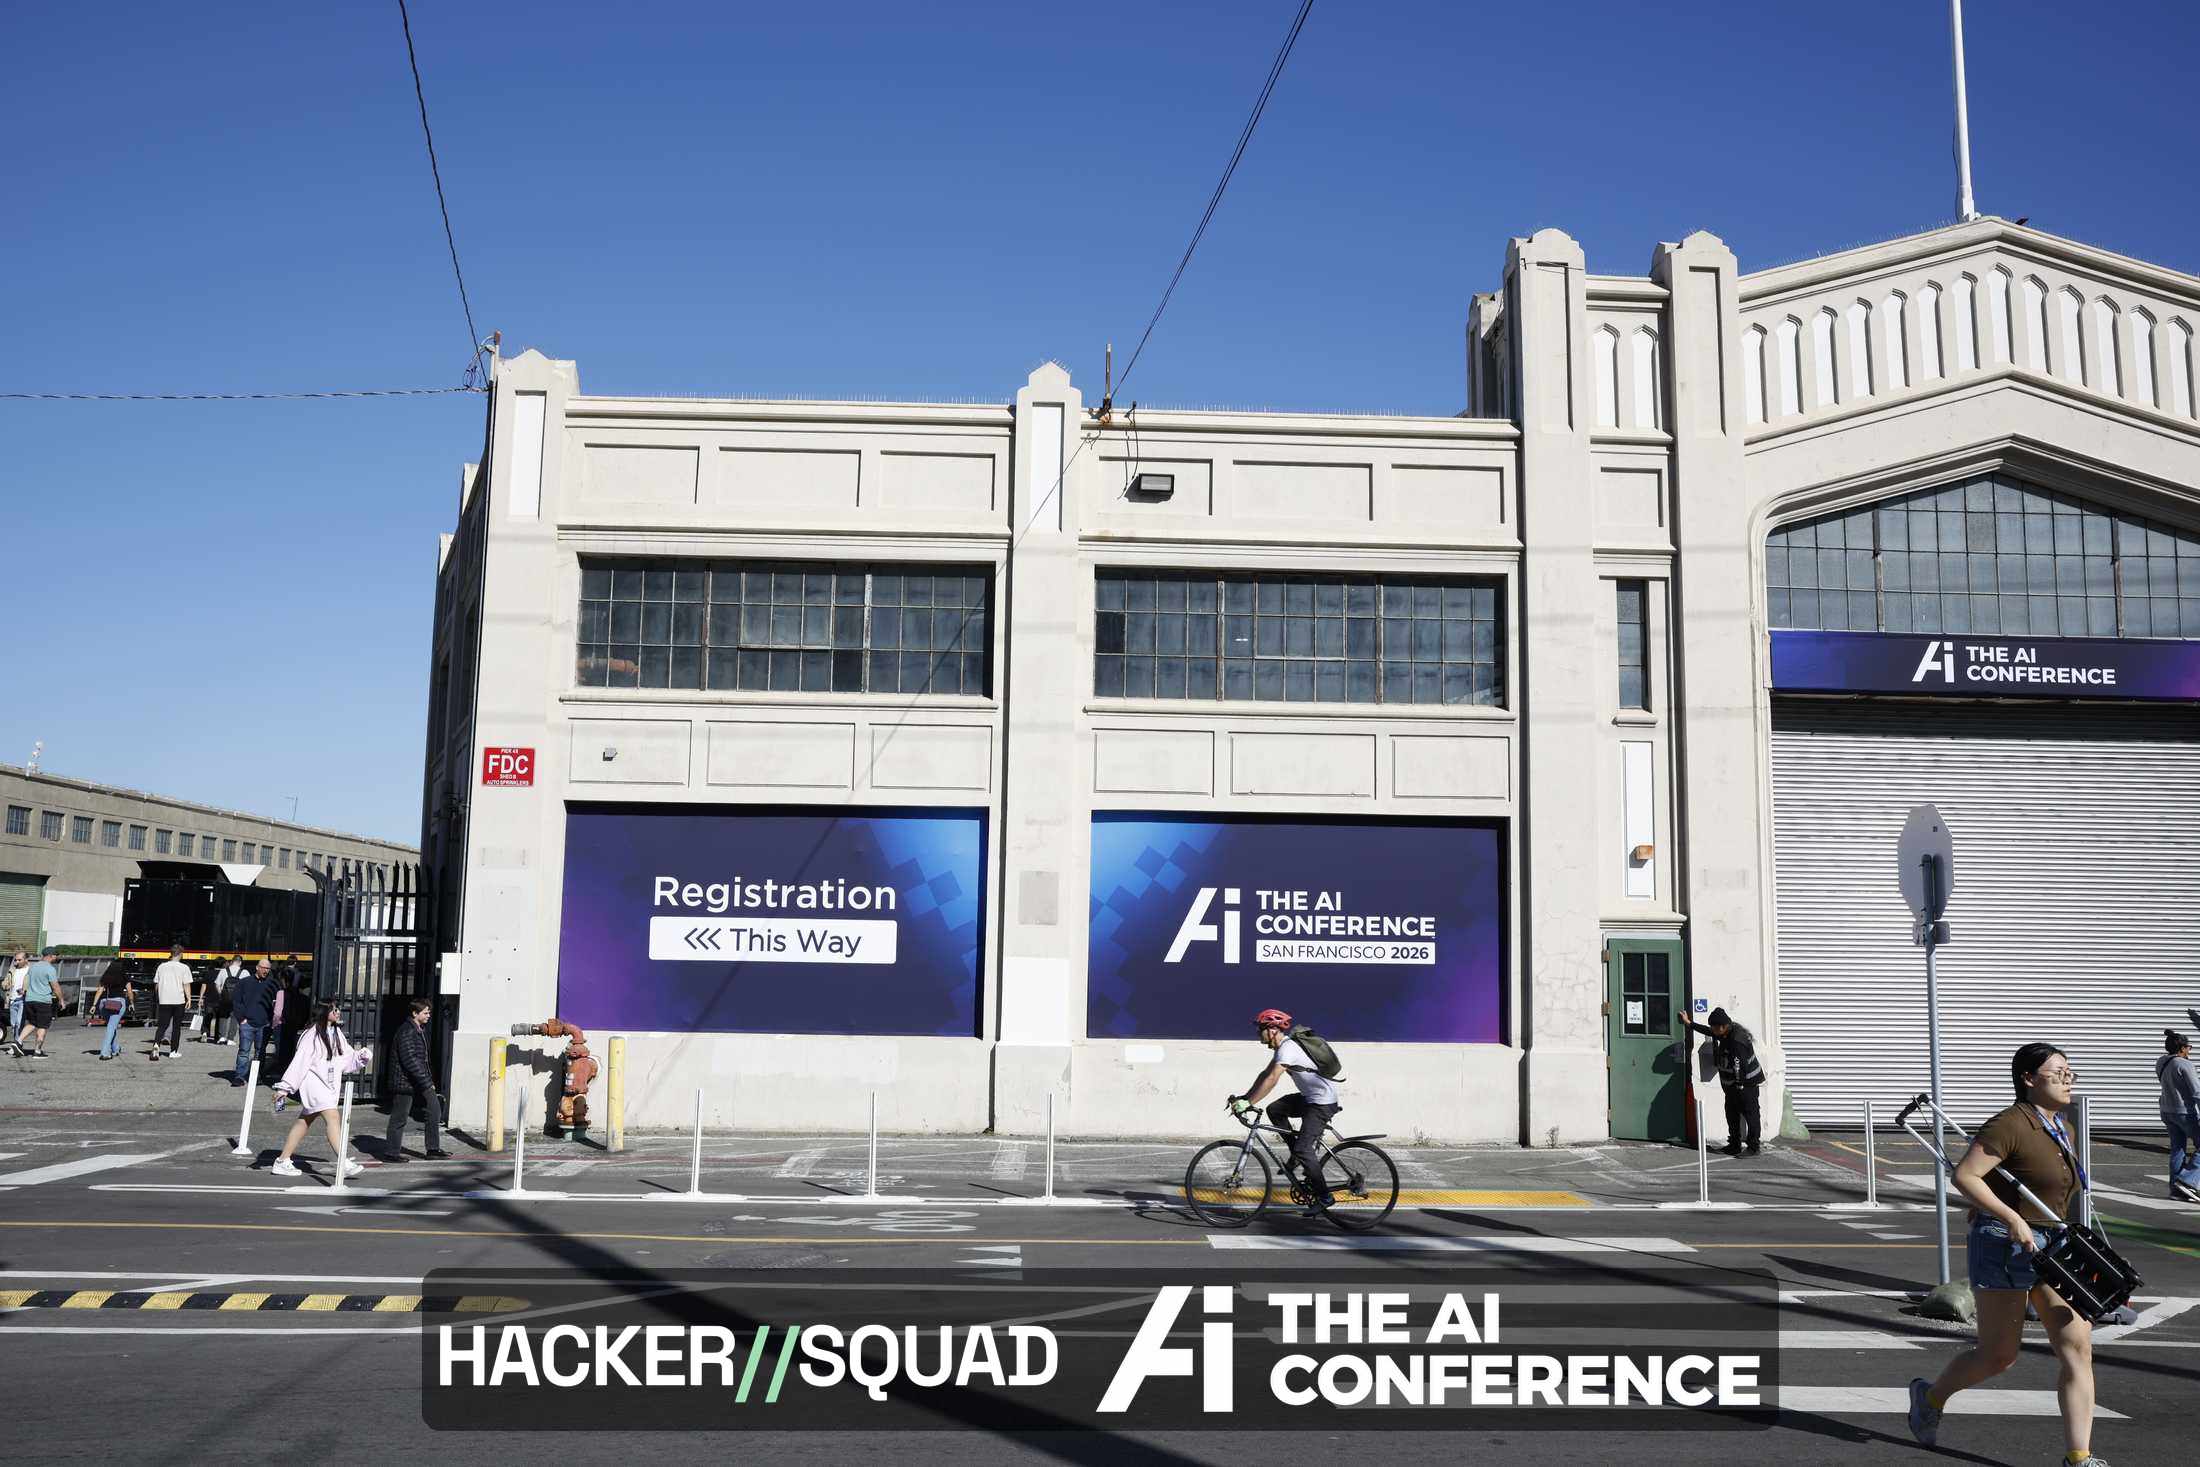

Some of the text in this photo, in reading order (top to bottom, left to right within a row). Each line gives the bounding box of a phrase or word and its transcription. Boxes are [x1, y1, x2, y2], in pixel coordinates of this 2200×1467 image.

[1965, 646, 2036, 664] THE AI
[1966, 665, 2116, 685] CONFERENCE
[488, 754, 529, 774] FDC
[654, 876, 896, 913] Registration
[1255, 890, 1342, 911] THE AI
[1255, 914, 1436, 937] CONFERENCE
[729, 927, 862, 958] This Way
[1262, 944, 1430, 960] SAN FRANCISCO 2026
